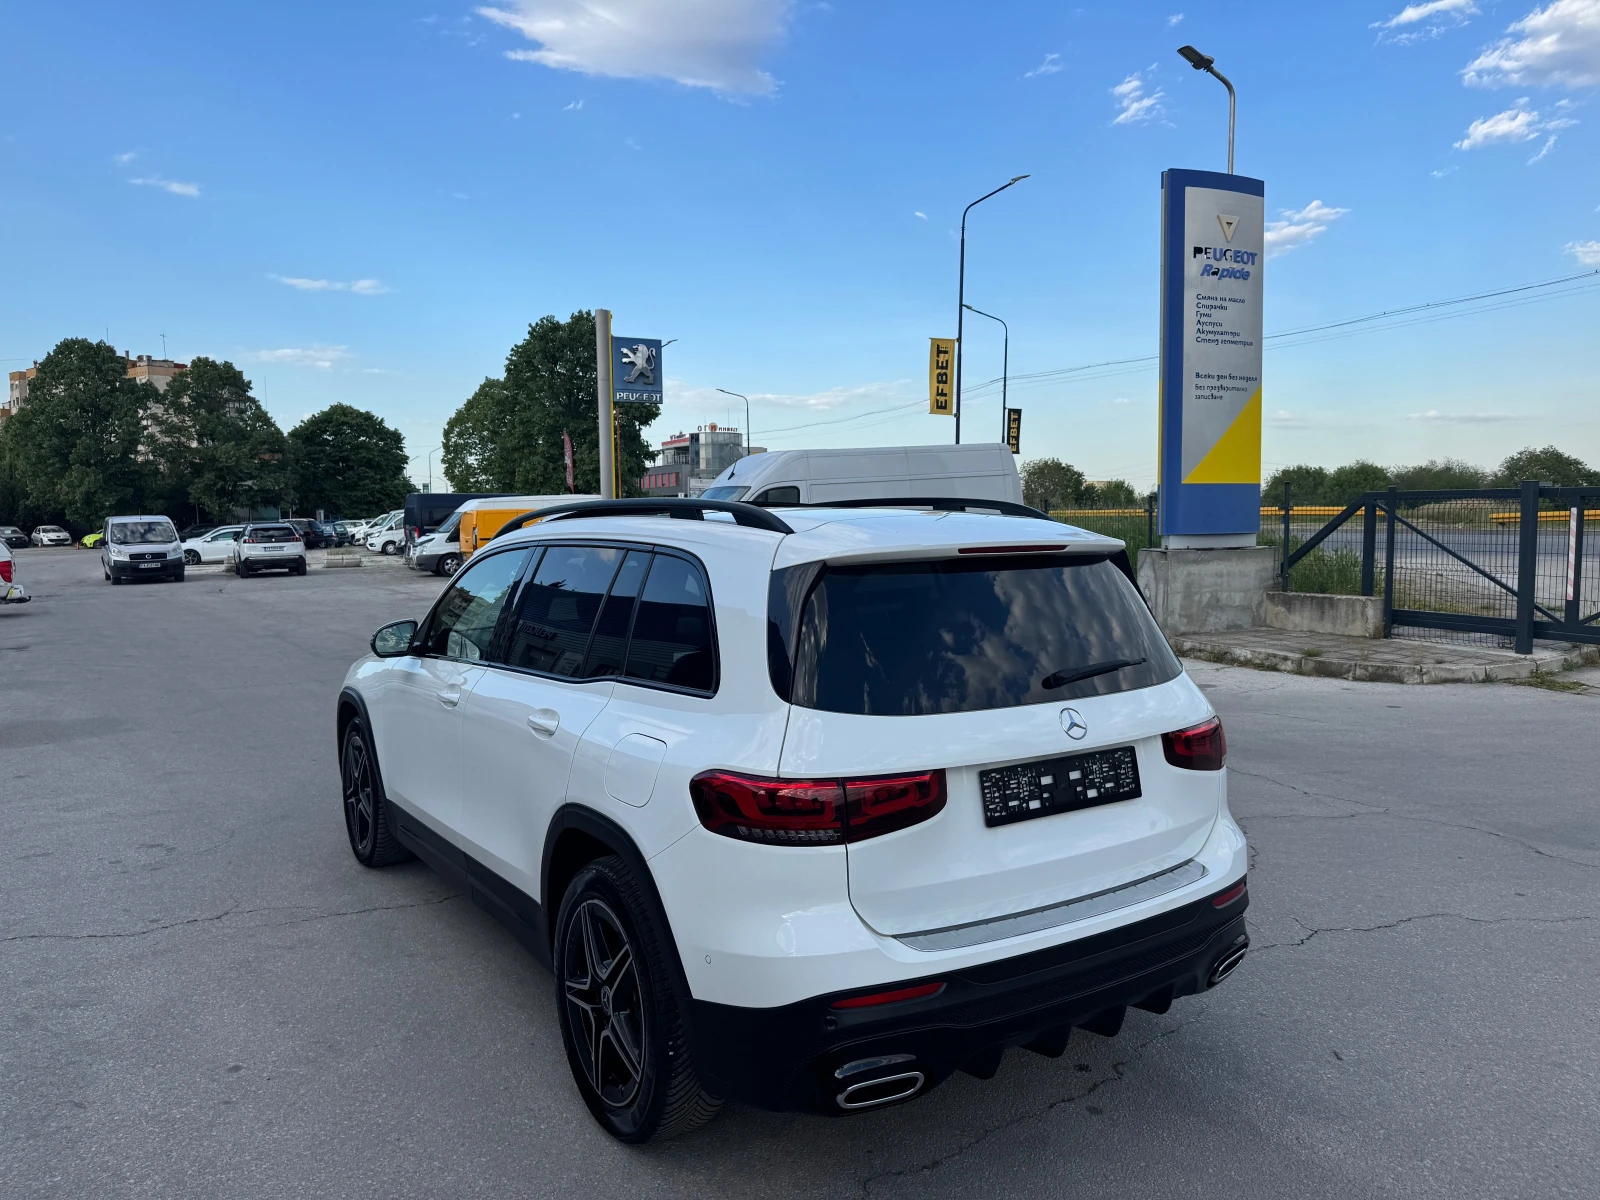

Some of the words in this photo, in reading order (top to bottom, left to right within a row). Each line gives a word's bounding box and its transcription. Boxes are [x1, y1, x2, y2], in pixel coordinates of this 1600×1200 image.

[1193, 246, 1258, 265] PEUGEOT
[1200, 264, 1250, 280] Rapide
[1196, 293, 1218, 301] Смяна
[1196, 302, 1228, 311] Спирачки
[1196, 310, 1212, 318] Гуми
[1196, 328, 1241, 338] Акумулатори
[1196, 336, 1220, 346] Стенд
[936, 344, 949, 410] EFBET
[1195, 372, 1215, 380] Всеки
[1216, 374, 1228, 382] ден
[1228, 372, 1238, 381] без
[1010, 412, 1019, 452] EFBET
